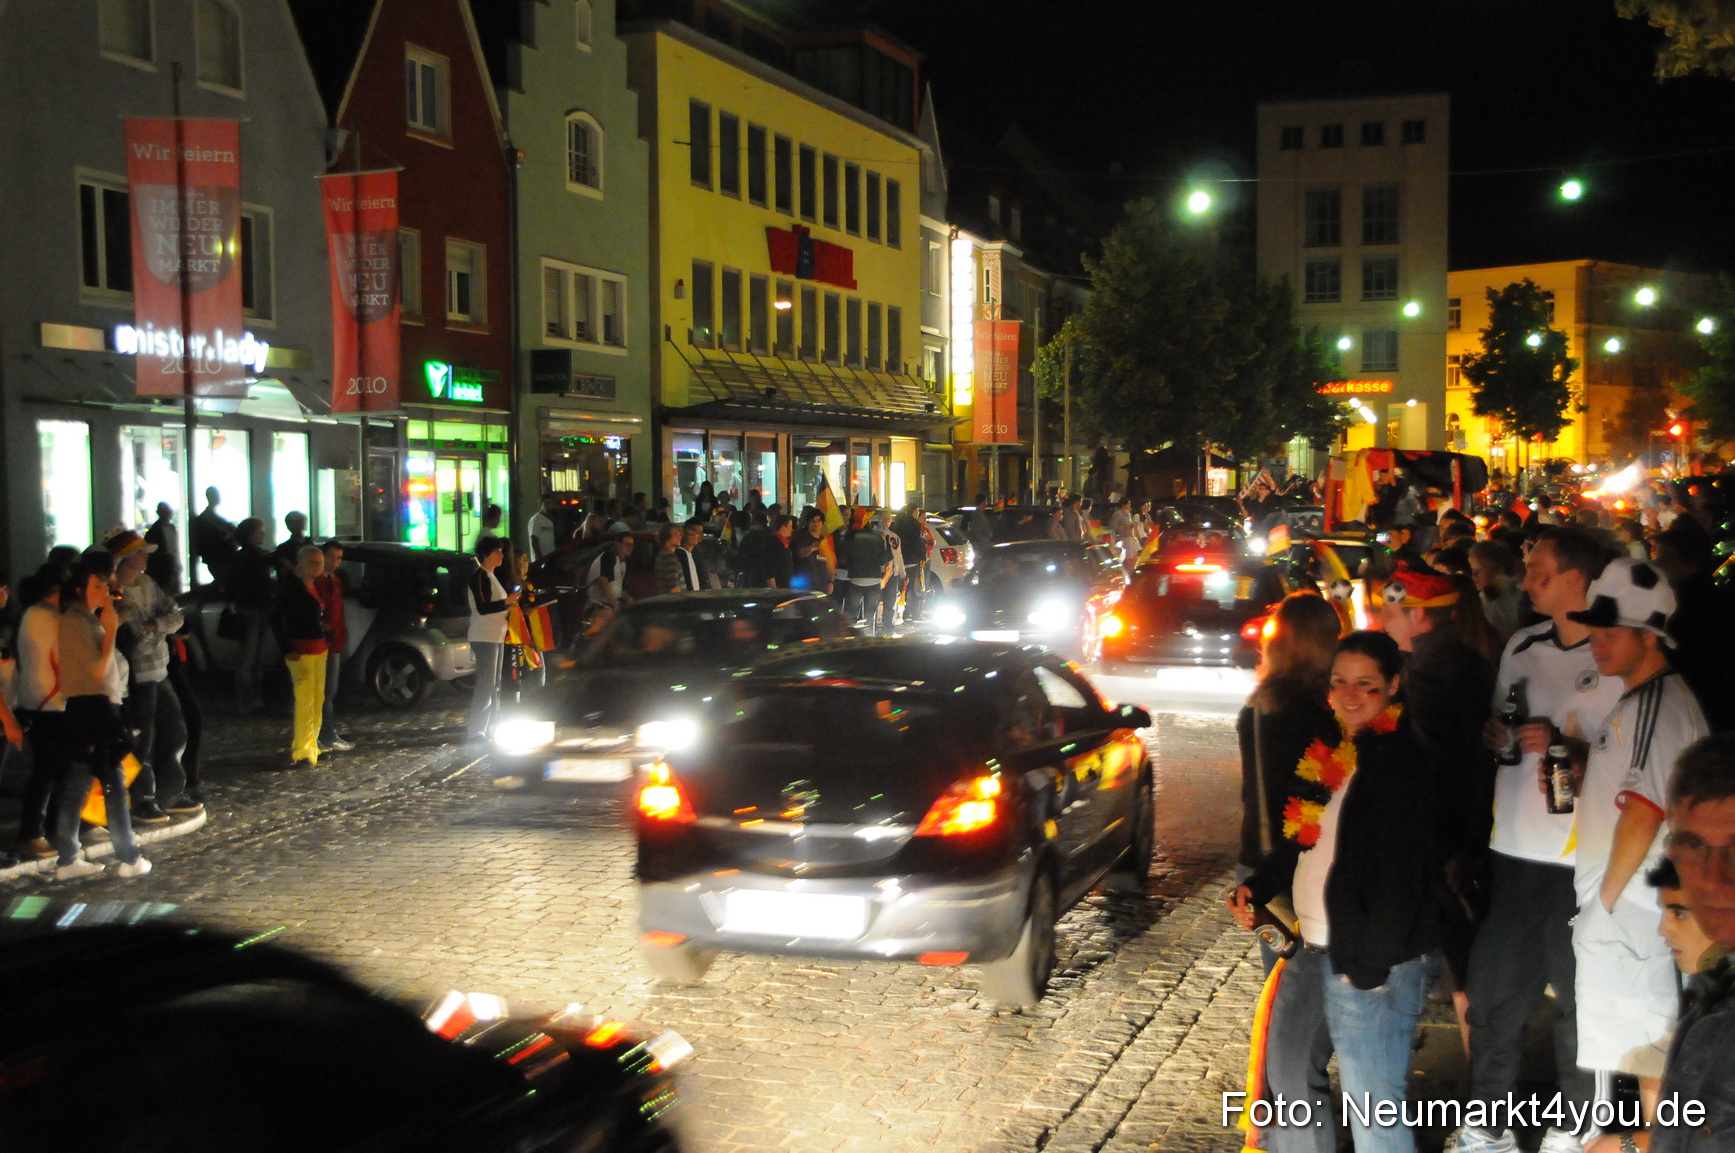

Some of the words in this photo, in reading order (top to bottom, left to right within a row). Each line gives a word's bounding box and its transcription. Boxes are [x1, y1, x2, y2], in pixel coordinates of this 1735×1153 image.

[132, 143, 170, 161] Wir
[328, 198, 353, 212] Wir
[347, 377, 387, 394] 2010
[982, 425, 1008, 434] 2010
